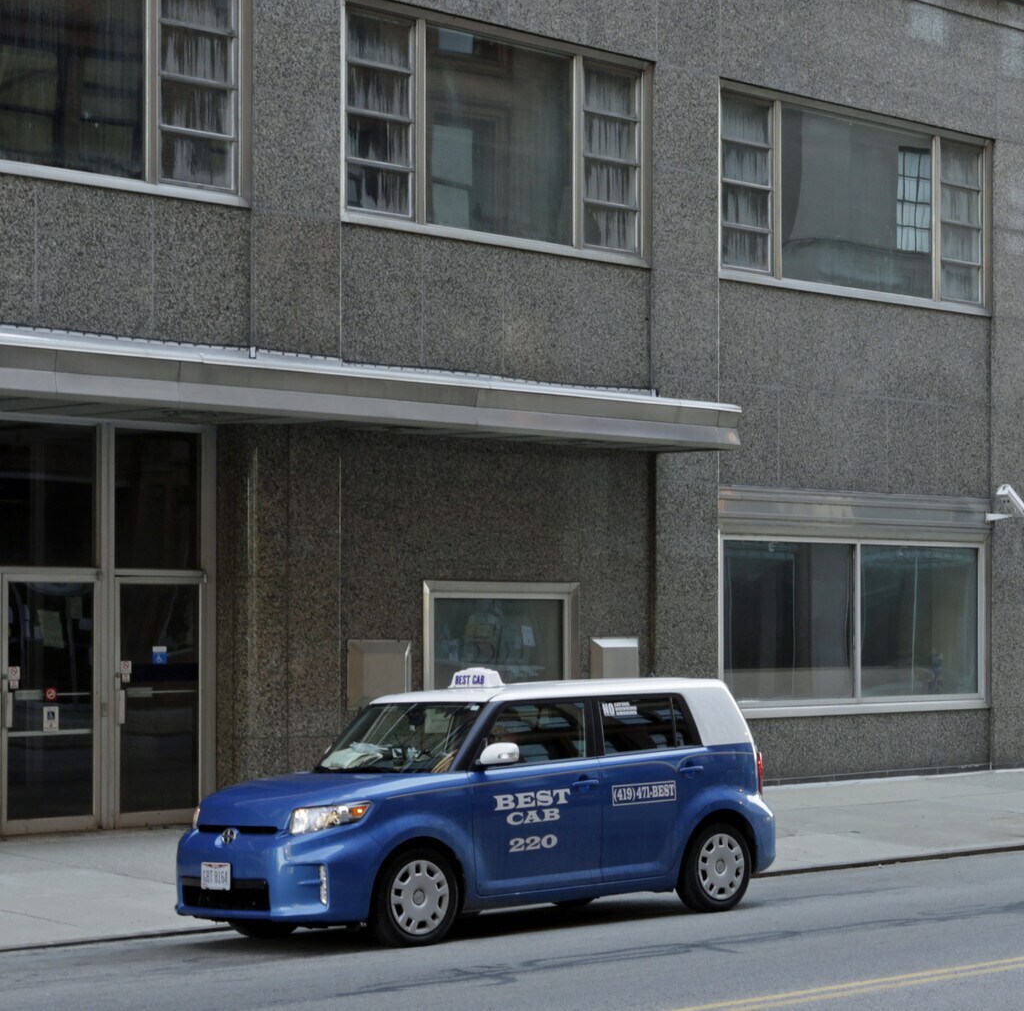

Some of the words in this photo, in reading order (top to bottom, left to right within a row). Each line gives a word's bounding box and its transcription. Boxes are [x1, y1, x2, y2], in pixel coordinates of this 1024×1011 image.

[455, 675, 470, 685] BEST
[472, 675, 485, 685] CAB
[602, 702, 615, 717] NO
[493, 788, 571, 811] BEST
[506, 808, 560, 826] CAB
[509, 834, 558, 853] 220
